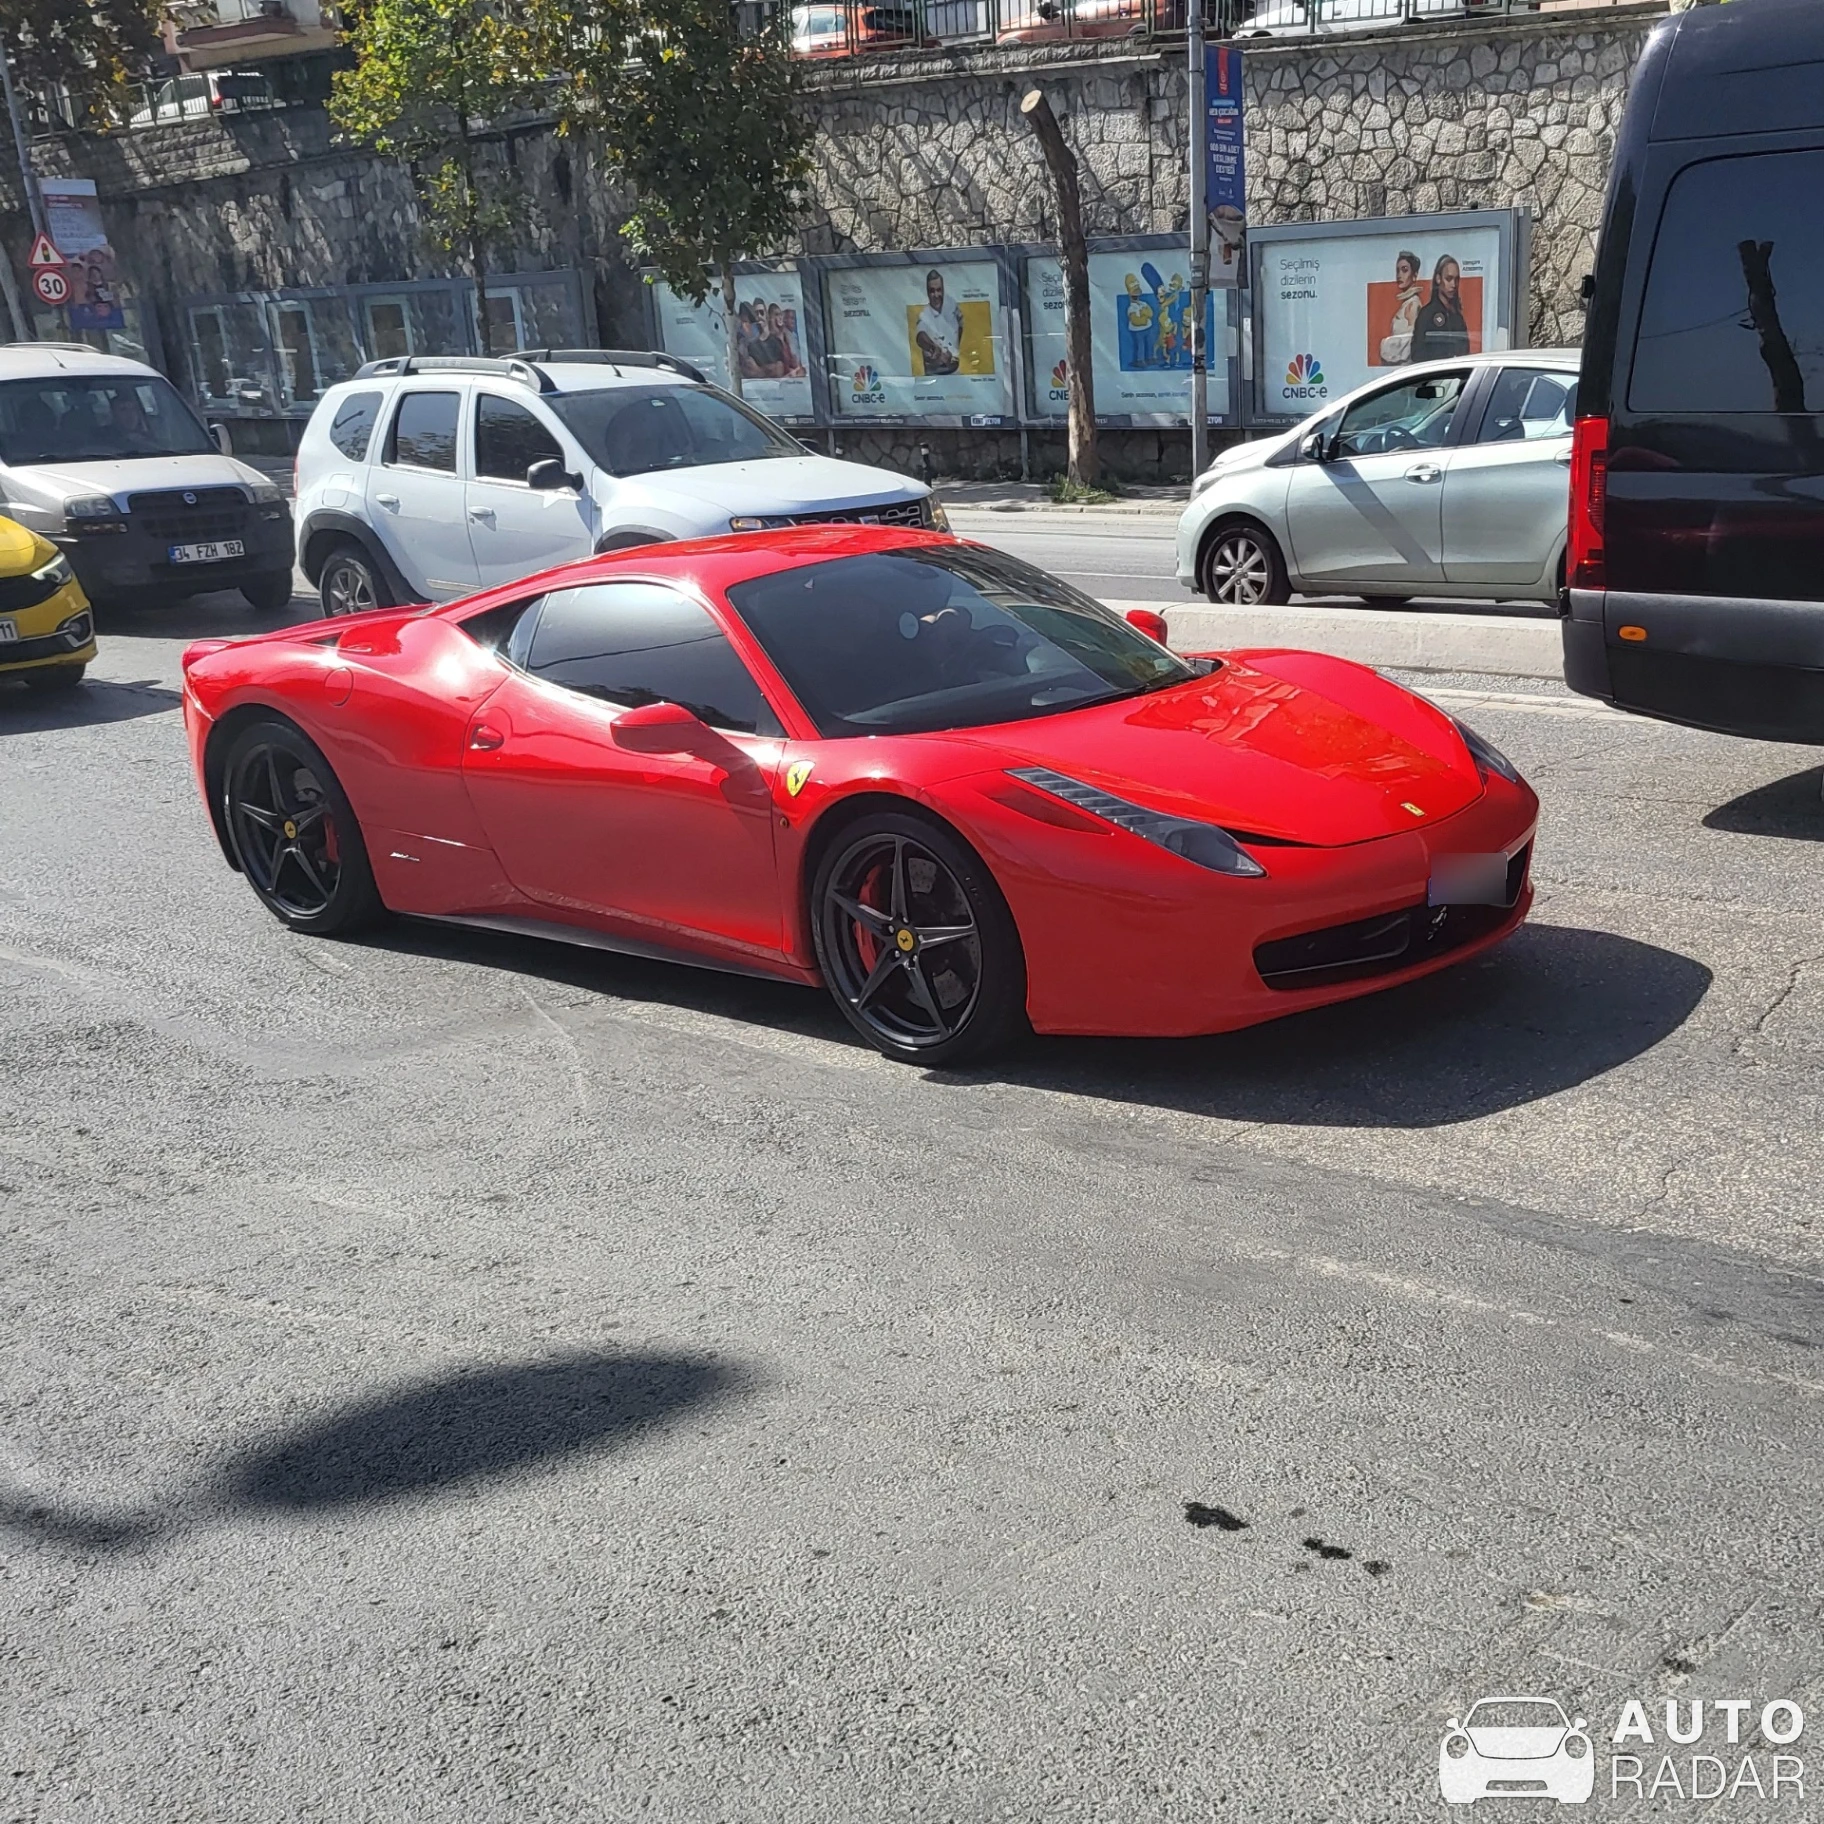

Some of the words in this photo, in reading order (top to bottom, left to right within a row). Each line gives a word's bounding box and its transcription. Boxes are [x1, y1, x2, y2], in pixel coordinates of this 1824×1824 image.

[1280, 257, 1320, 273] Seçilmiş
[1280, 273, 1316, 286] dizilerin
[41, 278, 63, 295] 30
[1280, 290, 1318, 300] sezonu.
[1043, 301, 1064, 310] sezo
[851, 393, 886, 403] CNBC-e
[1282, 386, 1328, 399] CNBC-e
[174, 546, 190, 561] 34
[196, 543, 218, 558] FZH
[223, 541, 243, 555] 182
